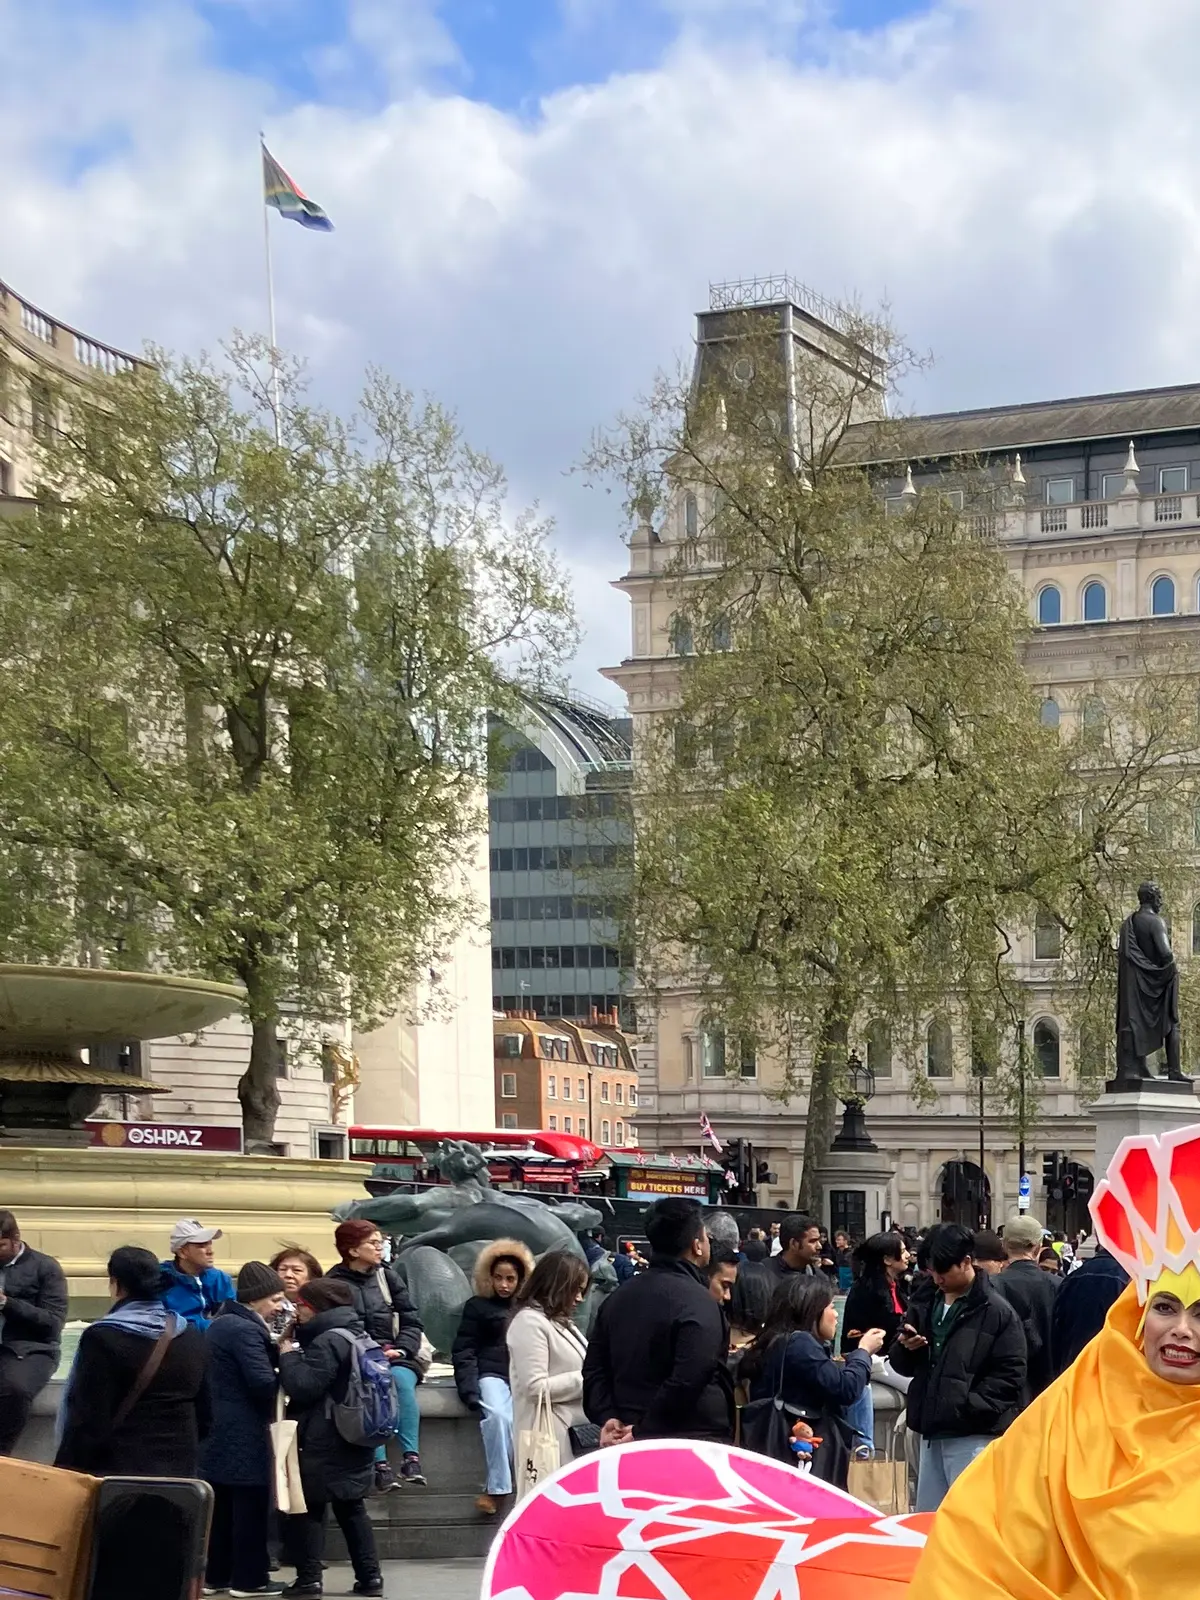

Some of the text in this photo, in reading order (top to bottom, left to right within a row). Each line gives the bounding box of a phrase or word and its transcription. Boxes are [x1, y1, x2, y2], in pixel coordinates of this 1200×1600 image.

[128, 1128, 203, 1146] OSHPAZ
[631, 1183, 706, 1195] BUY TICKETS HERE
